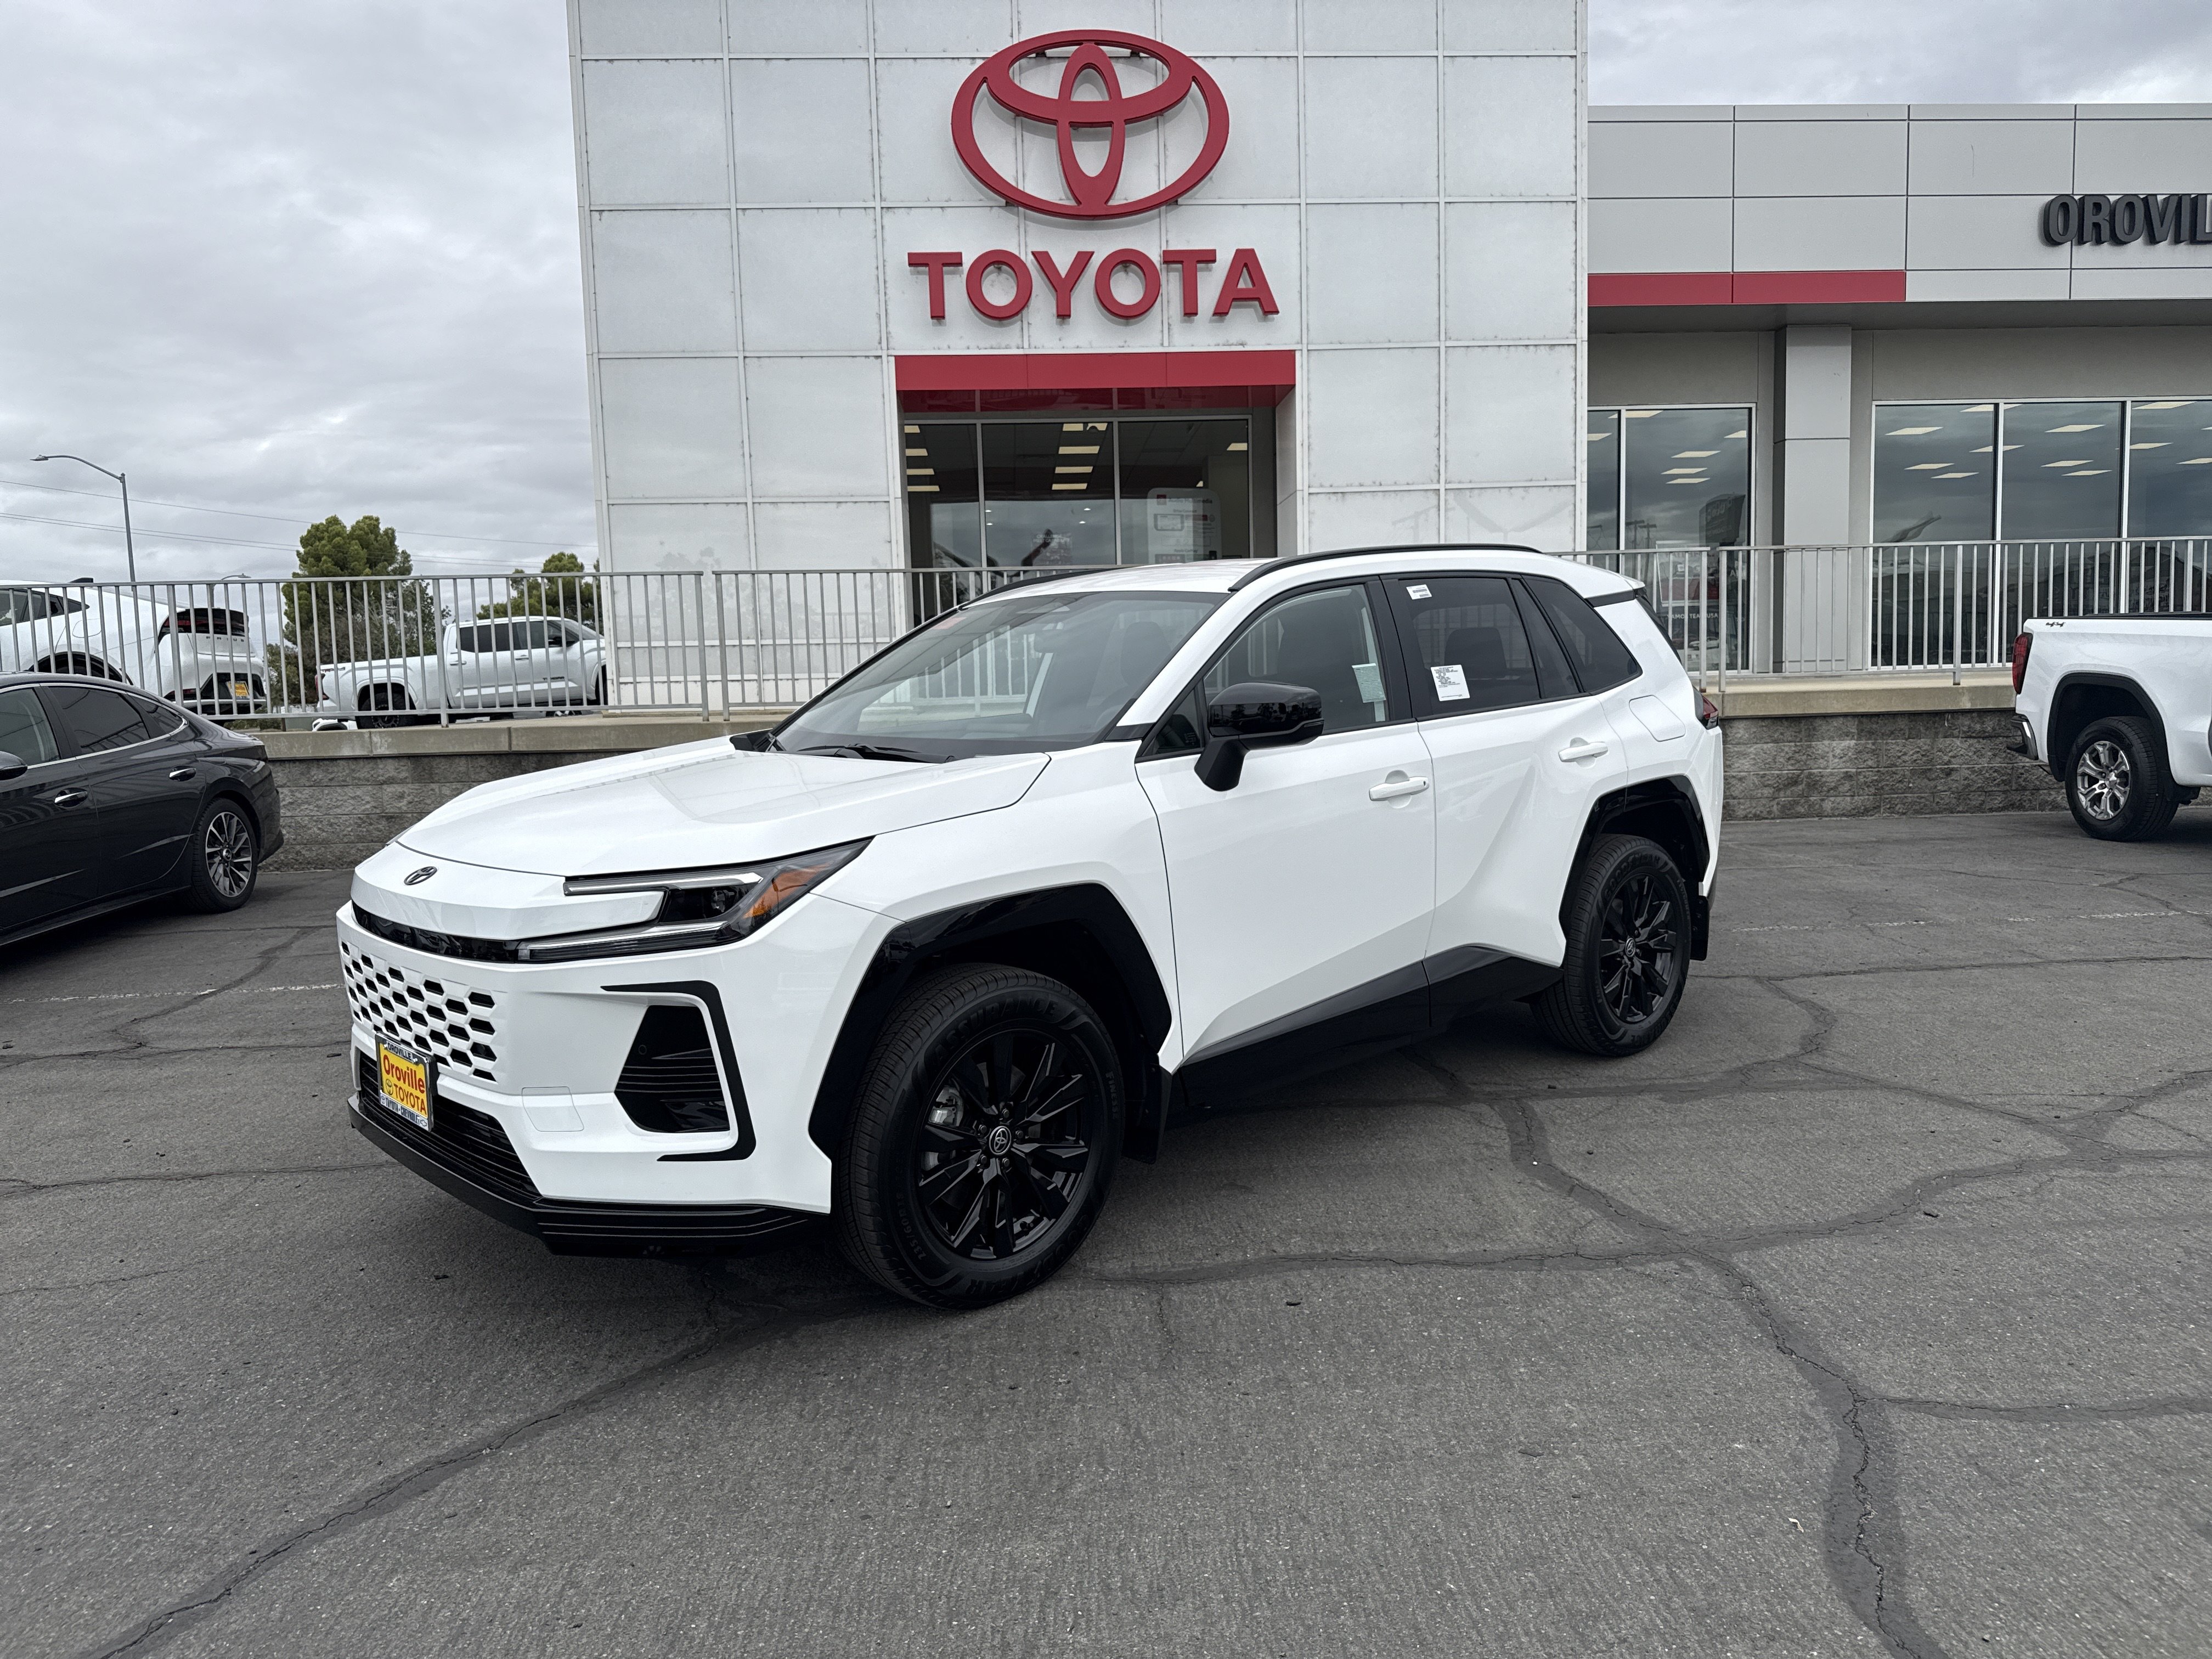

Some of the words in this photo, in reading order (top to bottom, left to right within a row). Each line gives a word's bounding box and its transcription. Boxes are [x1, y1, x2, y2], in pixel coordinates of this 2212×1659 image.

[2043, 194, 2212, 245] OROVIL
[907, 248, 1280, 320] TOYOTA
[387, 1042, 413, 1060] OROVILLE
[932, 996, 1059, 1062] ASSURANCE
[383, 1054, 425, 1094] Oroville
[393, 1084, 427, 1115] TOYOTA
